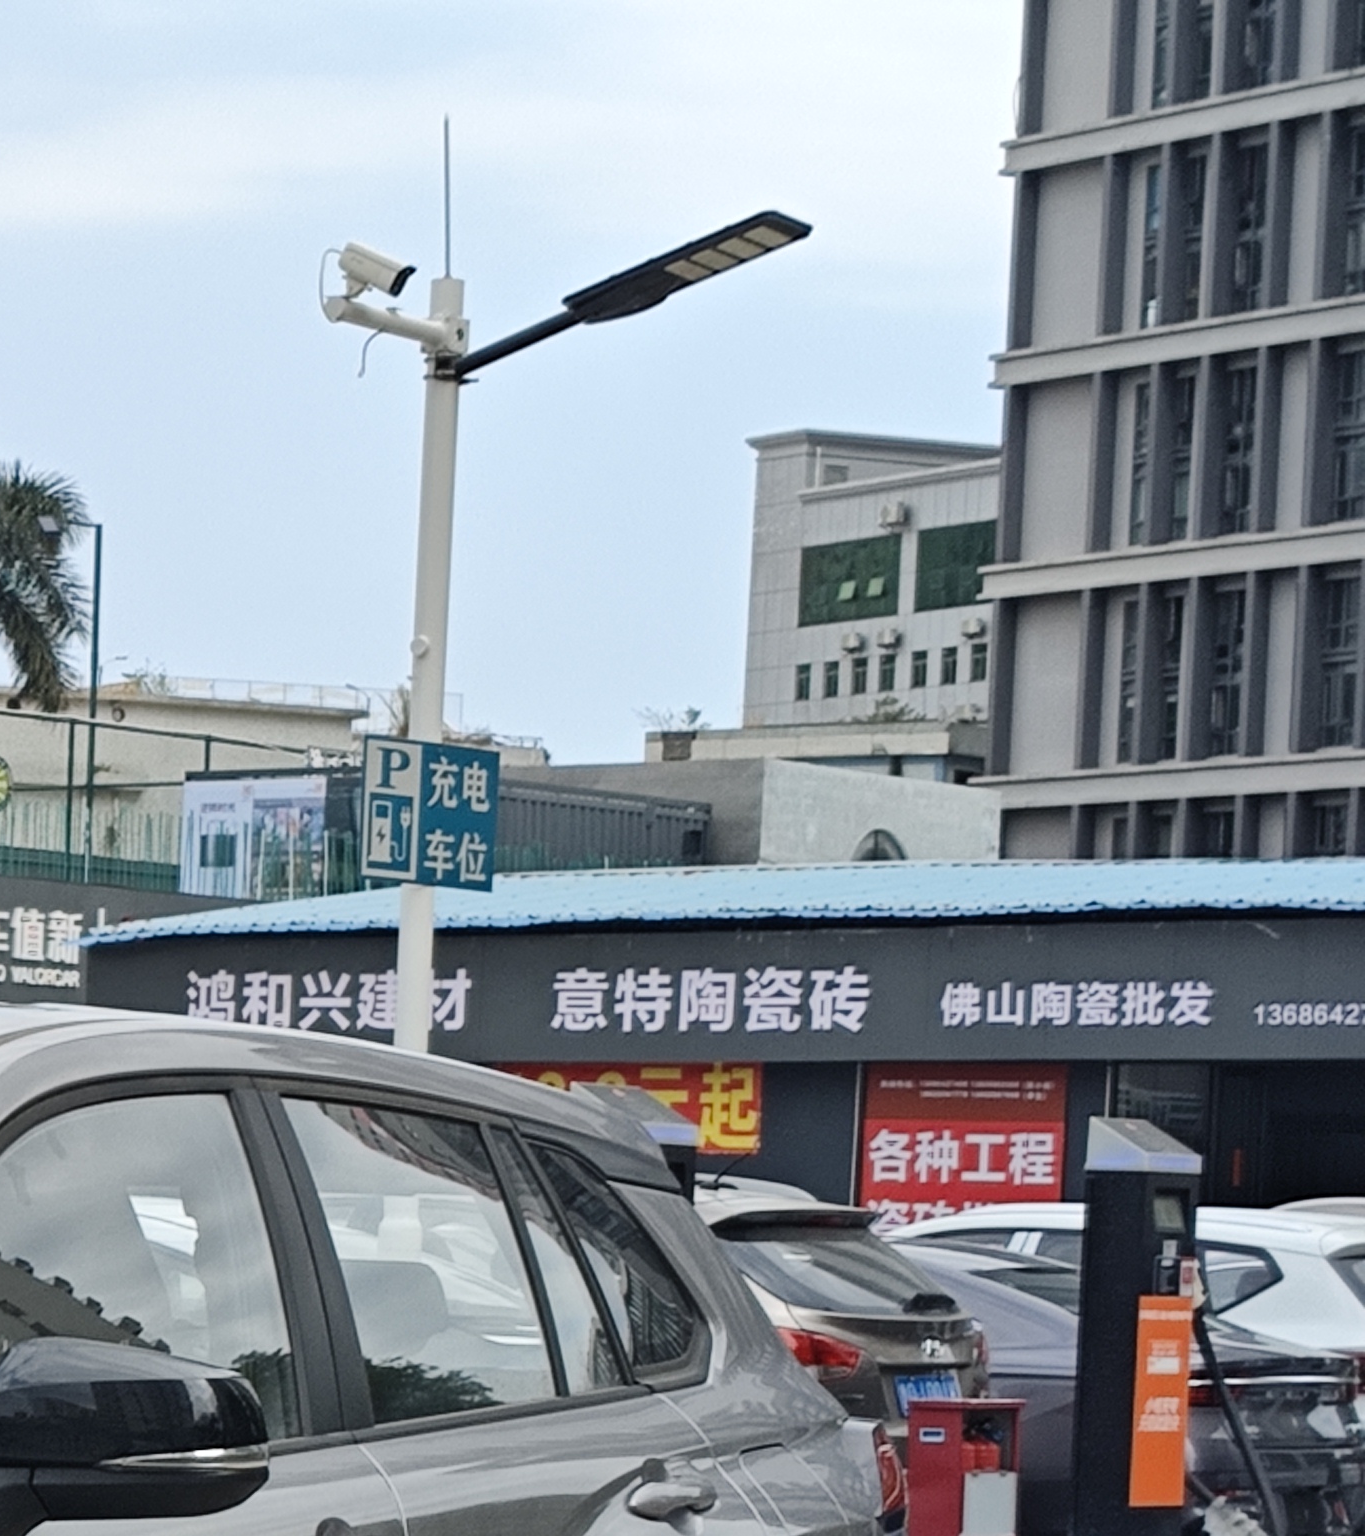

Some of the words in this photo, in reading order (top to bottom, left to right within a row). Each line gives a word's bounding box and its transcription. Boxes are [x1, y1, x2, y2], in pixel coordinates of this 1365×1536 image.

[376, 746, 411, 789] P
[426, 755, 491, 813] 充电
[423, 829, 488, 883] 车位
[11, 965, 81, 988] VALORCAR
[186, 968, 473, 1031] 鸿和兴建材
[550, 965, 871, 1033] 意特陶瓷砖
[940, 980, 1215, 1027] 佛山陶瓷批发
[868, 1128, 1056, 1186] 各种工程
